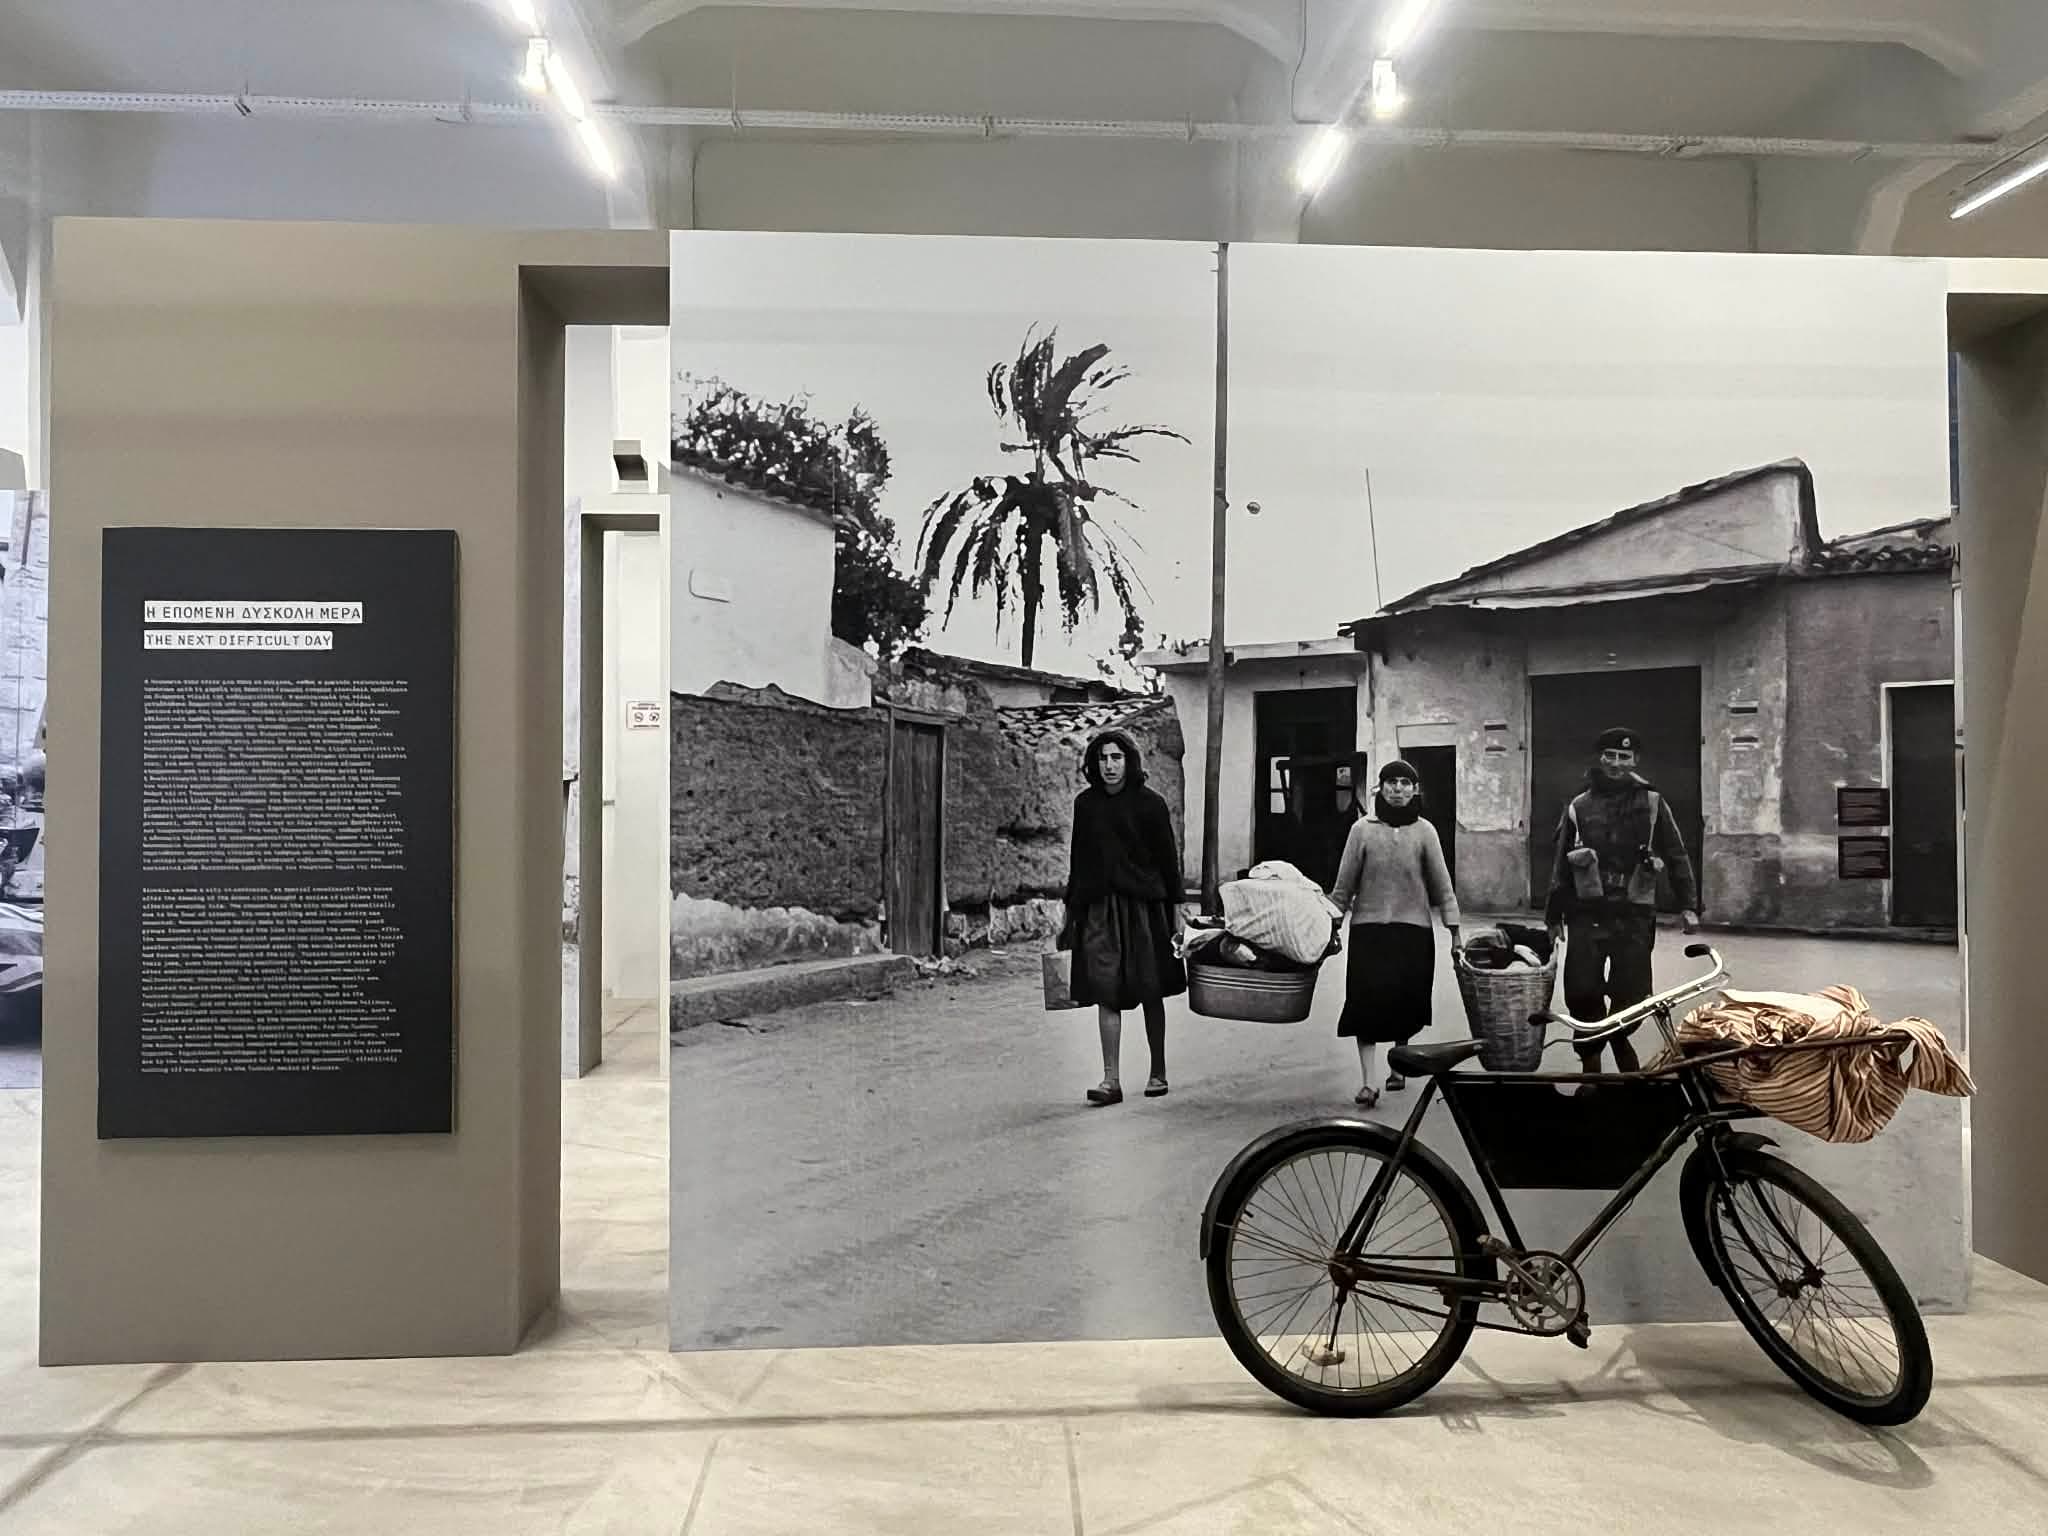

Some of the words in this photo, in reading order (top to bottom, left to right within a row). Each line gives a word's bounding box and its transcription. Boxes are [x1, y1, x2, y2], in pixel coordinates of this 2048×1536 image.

[163, 606, 235, 619] ΕΠΟΜΕΝΗ
[242, 607, 314, 619] ΔΥΣΚΟΛΗ
[320, 607, 361, 619] ΜΕΡΑ
[146, 634, 172, 646] THE
[178, 634, 215, 646] NEXT
[219, 635, 300, 646] DIFFICULT
[305, 635, 331, 646] DAY
